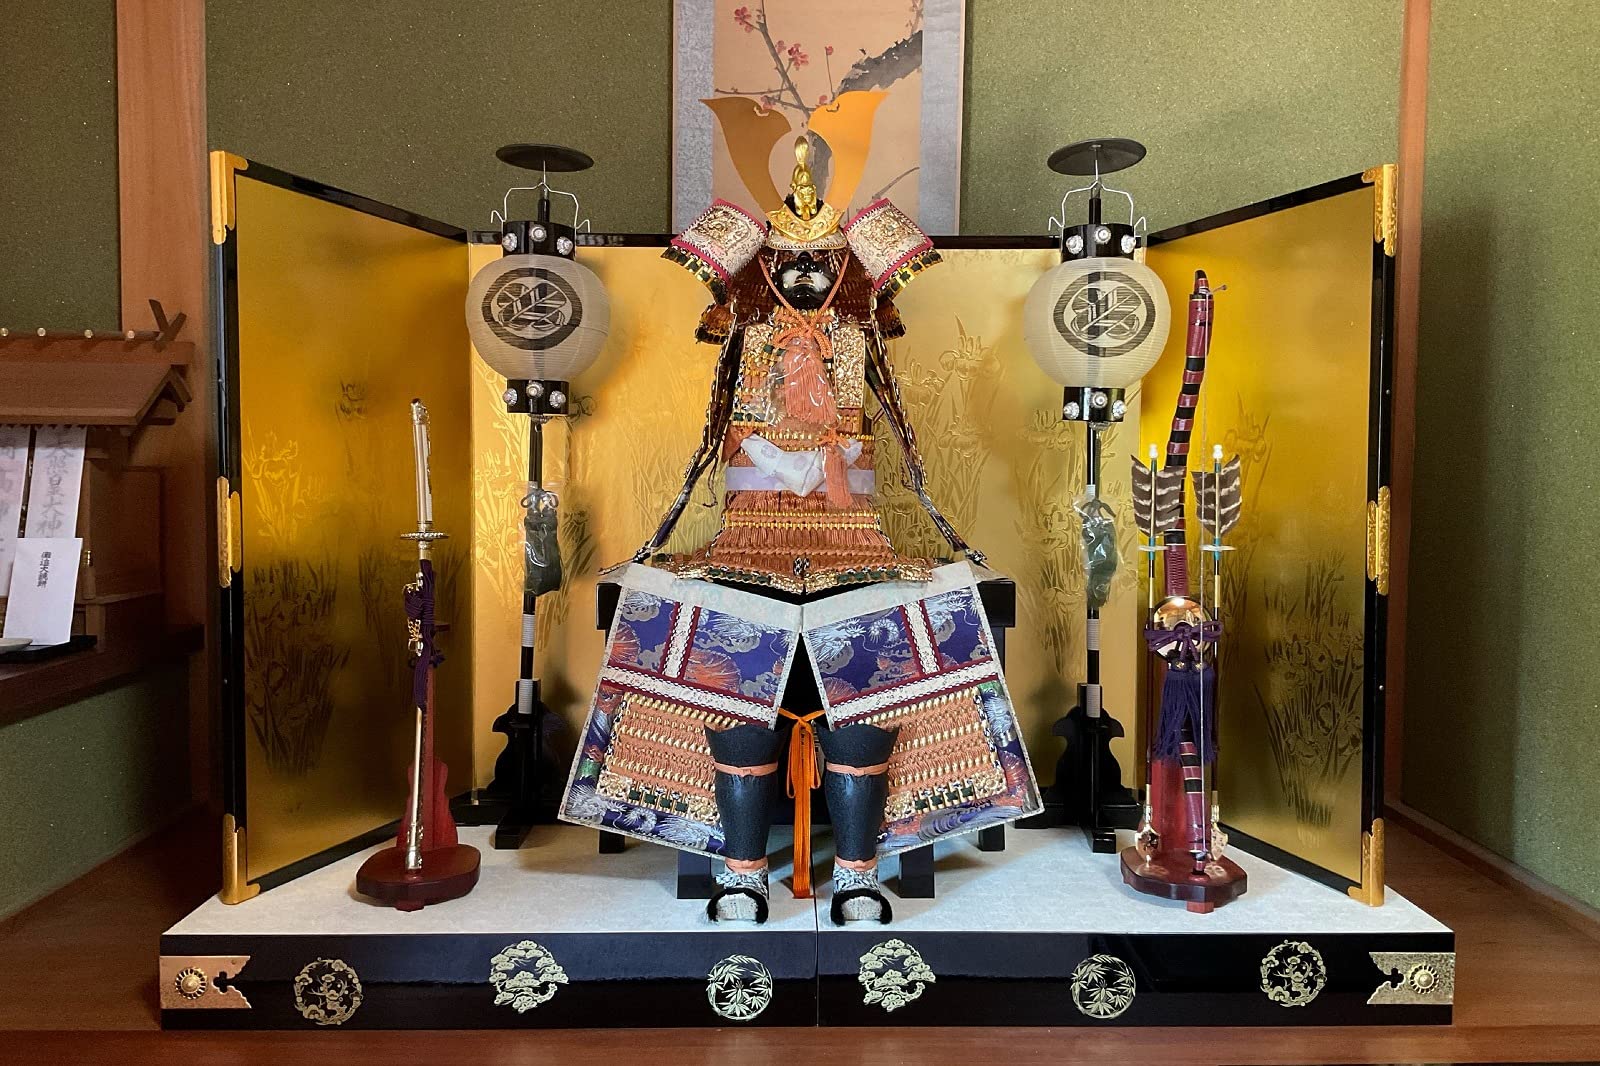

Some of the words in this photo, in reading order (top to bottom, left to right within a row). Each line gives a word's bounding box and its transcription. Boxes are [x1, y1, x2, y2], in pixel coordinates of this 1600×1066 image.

[36, 431, 74, 538] 天照皇大神
